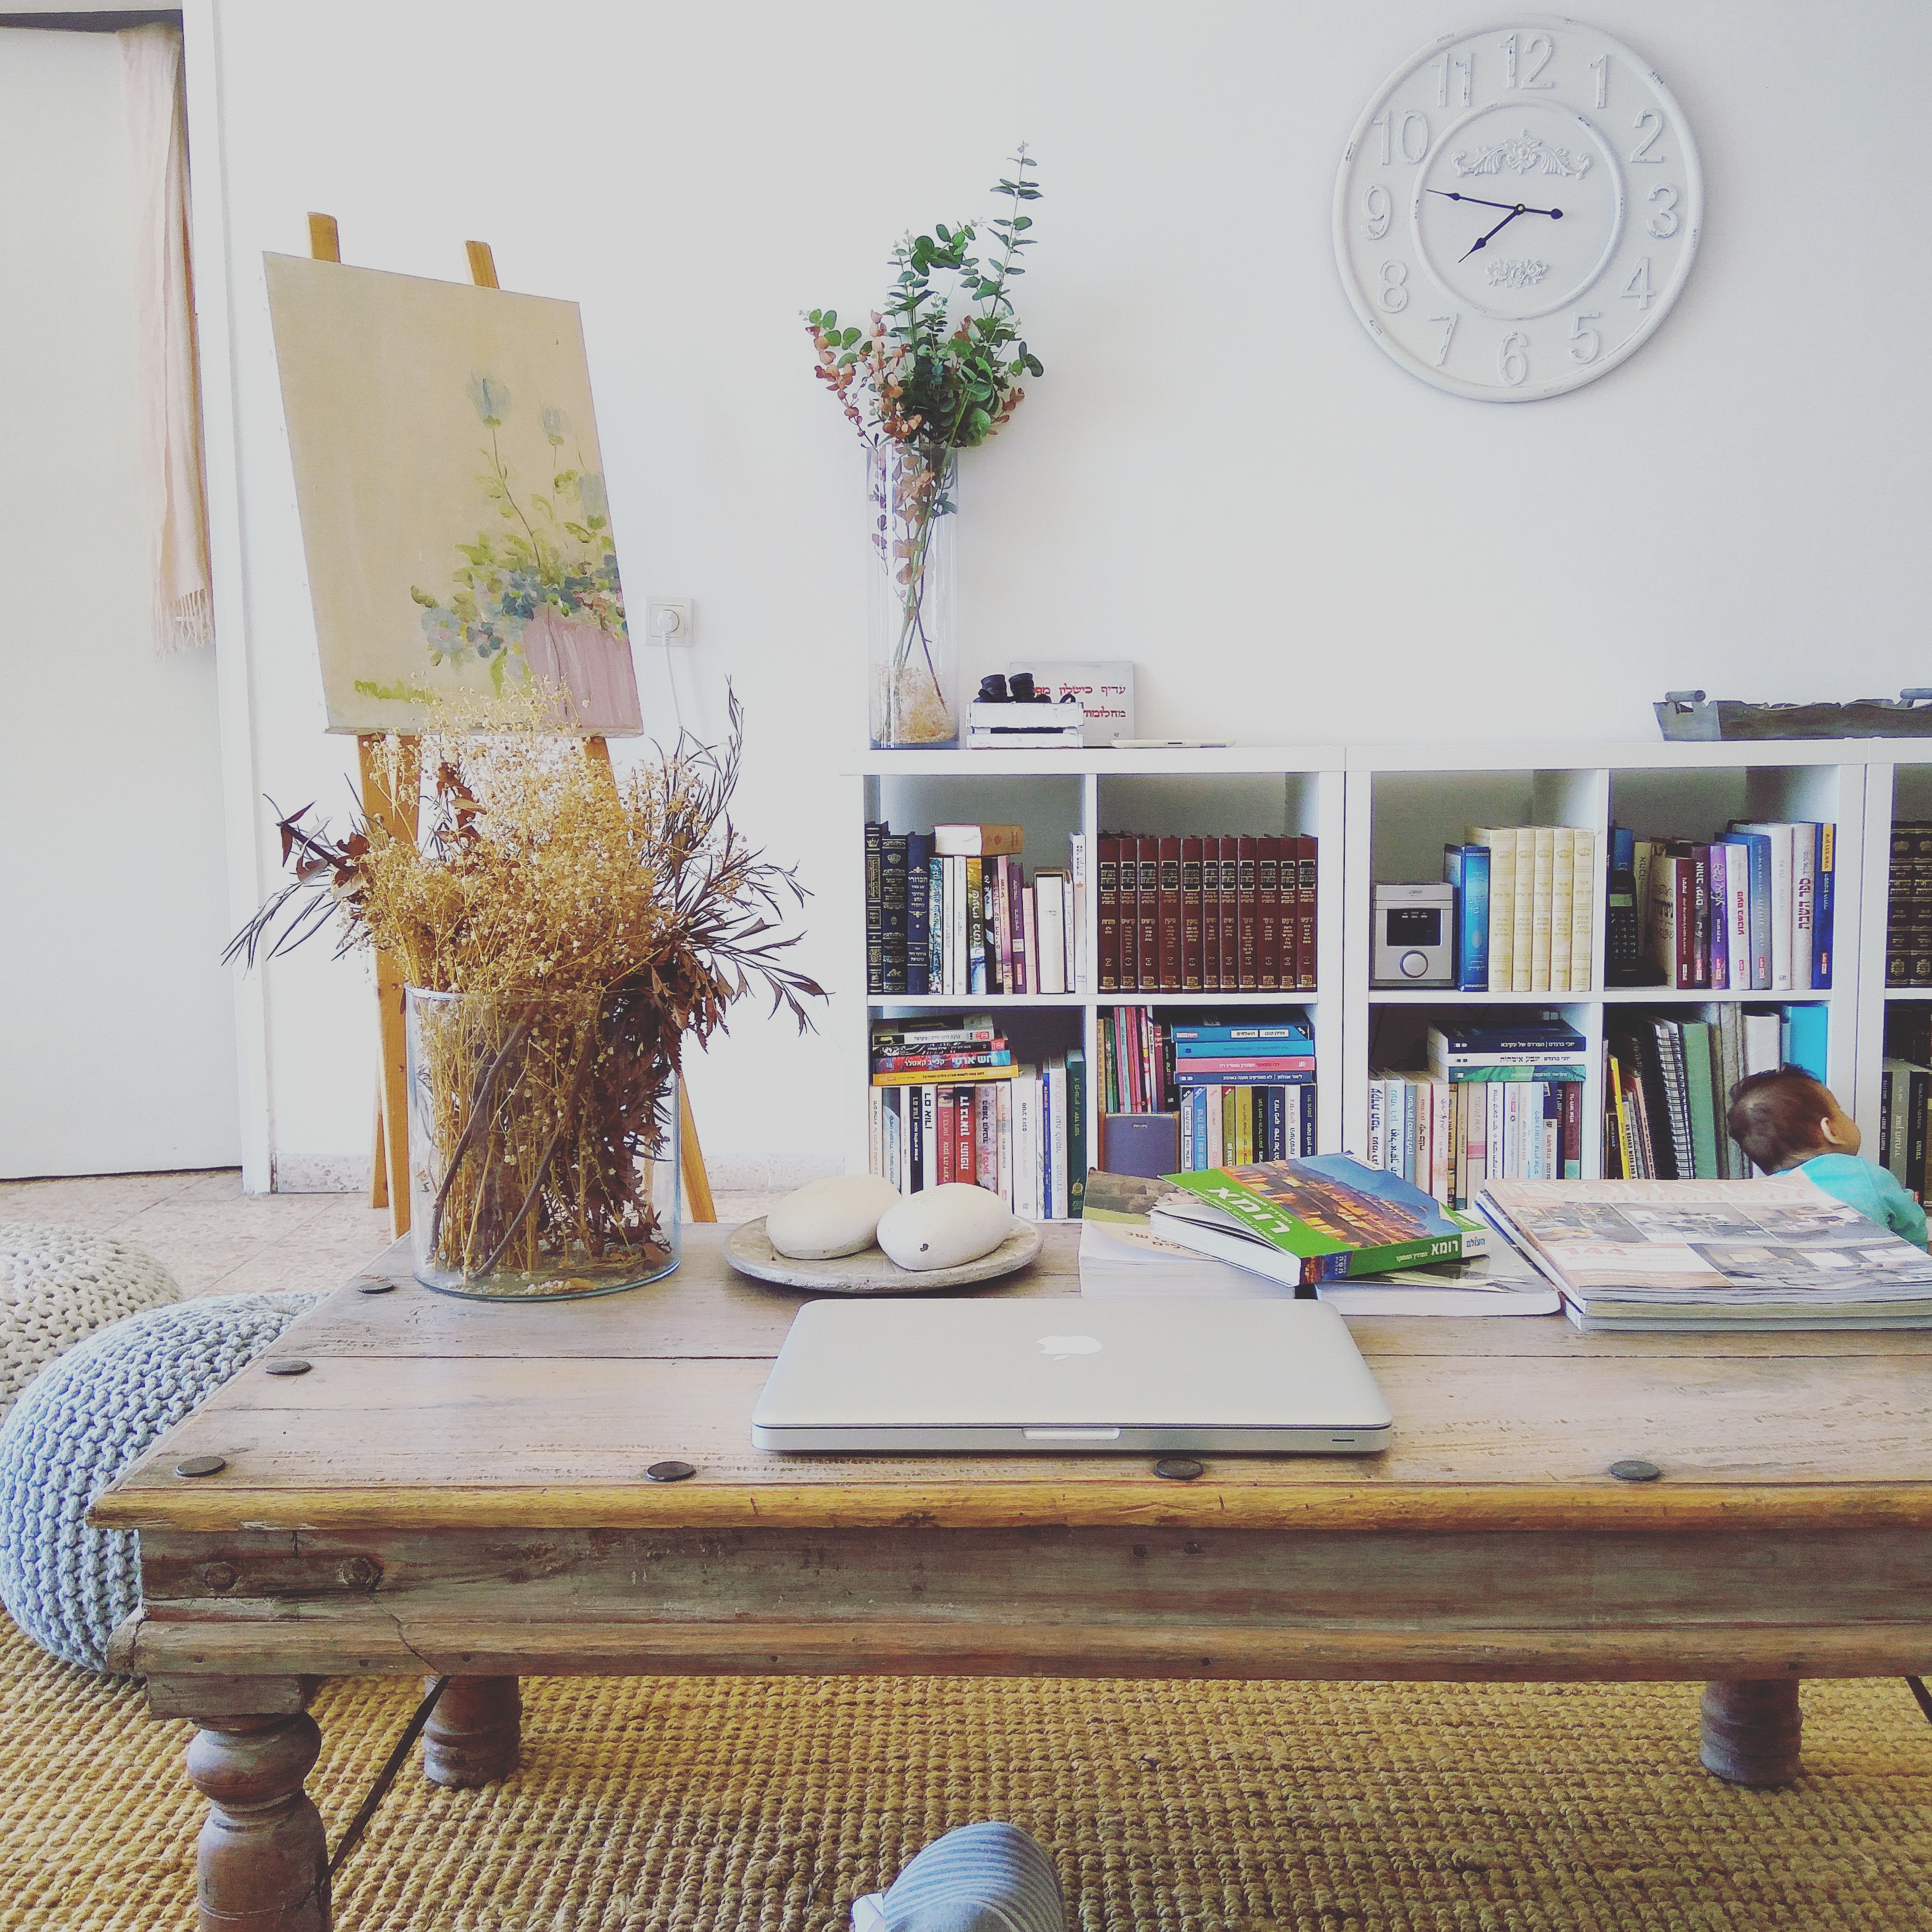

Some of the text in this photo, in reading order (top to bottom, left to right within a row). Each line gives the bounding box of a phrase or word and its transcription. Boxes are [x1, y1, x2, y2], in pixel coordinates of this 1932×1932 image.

[1431, 52, 1476, 108] 11
[1498, 33, 1555, 89] 12
[1588, 53, 1611, 109] 1
[1373, 110, 1429, 166] 10
[1630, 109, 1665, 163] 2
[1361, 184, 1391, 240] 9
[1646, 183, 1678, 239] 3
[1377, 260, 1409, 313] 8
[1619, 257, 1656, 310] 4
[1428, 312, 1459, 366] 7
[1497, 332, 1528, 385] 6
[1569, 311, 1604, 365] 5
[1059, 683, 1126, 696] עדיף כישלון
[1695, 861, 1704, 906] אוהב ימים
[1799, 878, 1811, 897] ספר
[1798, 901, 1811, 930] השבת
[913, 1097, 918, 1105] רם
[924, 1093, 931, 1106] רם
[1371, 1088, 1383, 1111] עקדת
[1371, 1113, 1380, 1131] תמר
[960, 1096, 970, 1169] דן בראון התופת
[982, 1122, 990, 1144] האבוד
[1273, 1142, 1280, 1151] של
[1205, 1187, 1290, 1233] רומא
[1431, 1239, 1459, 1256] רומא
[1561, 1247, 1629, 1256] 144
